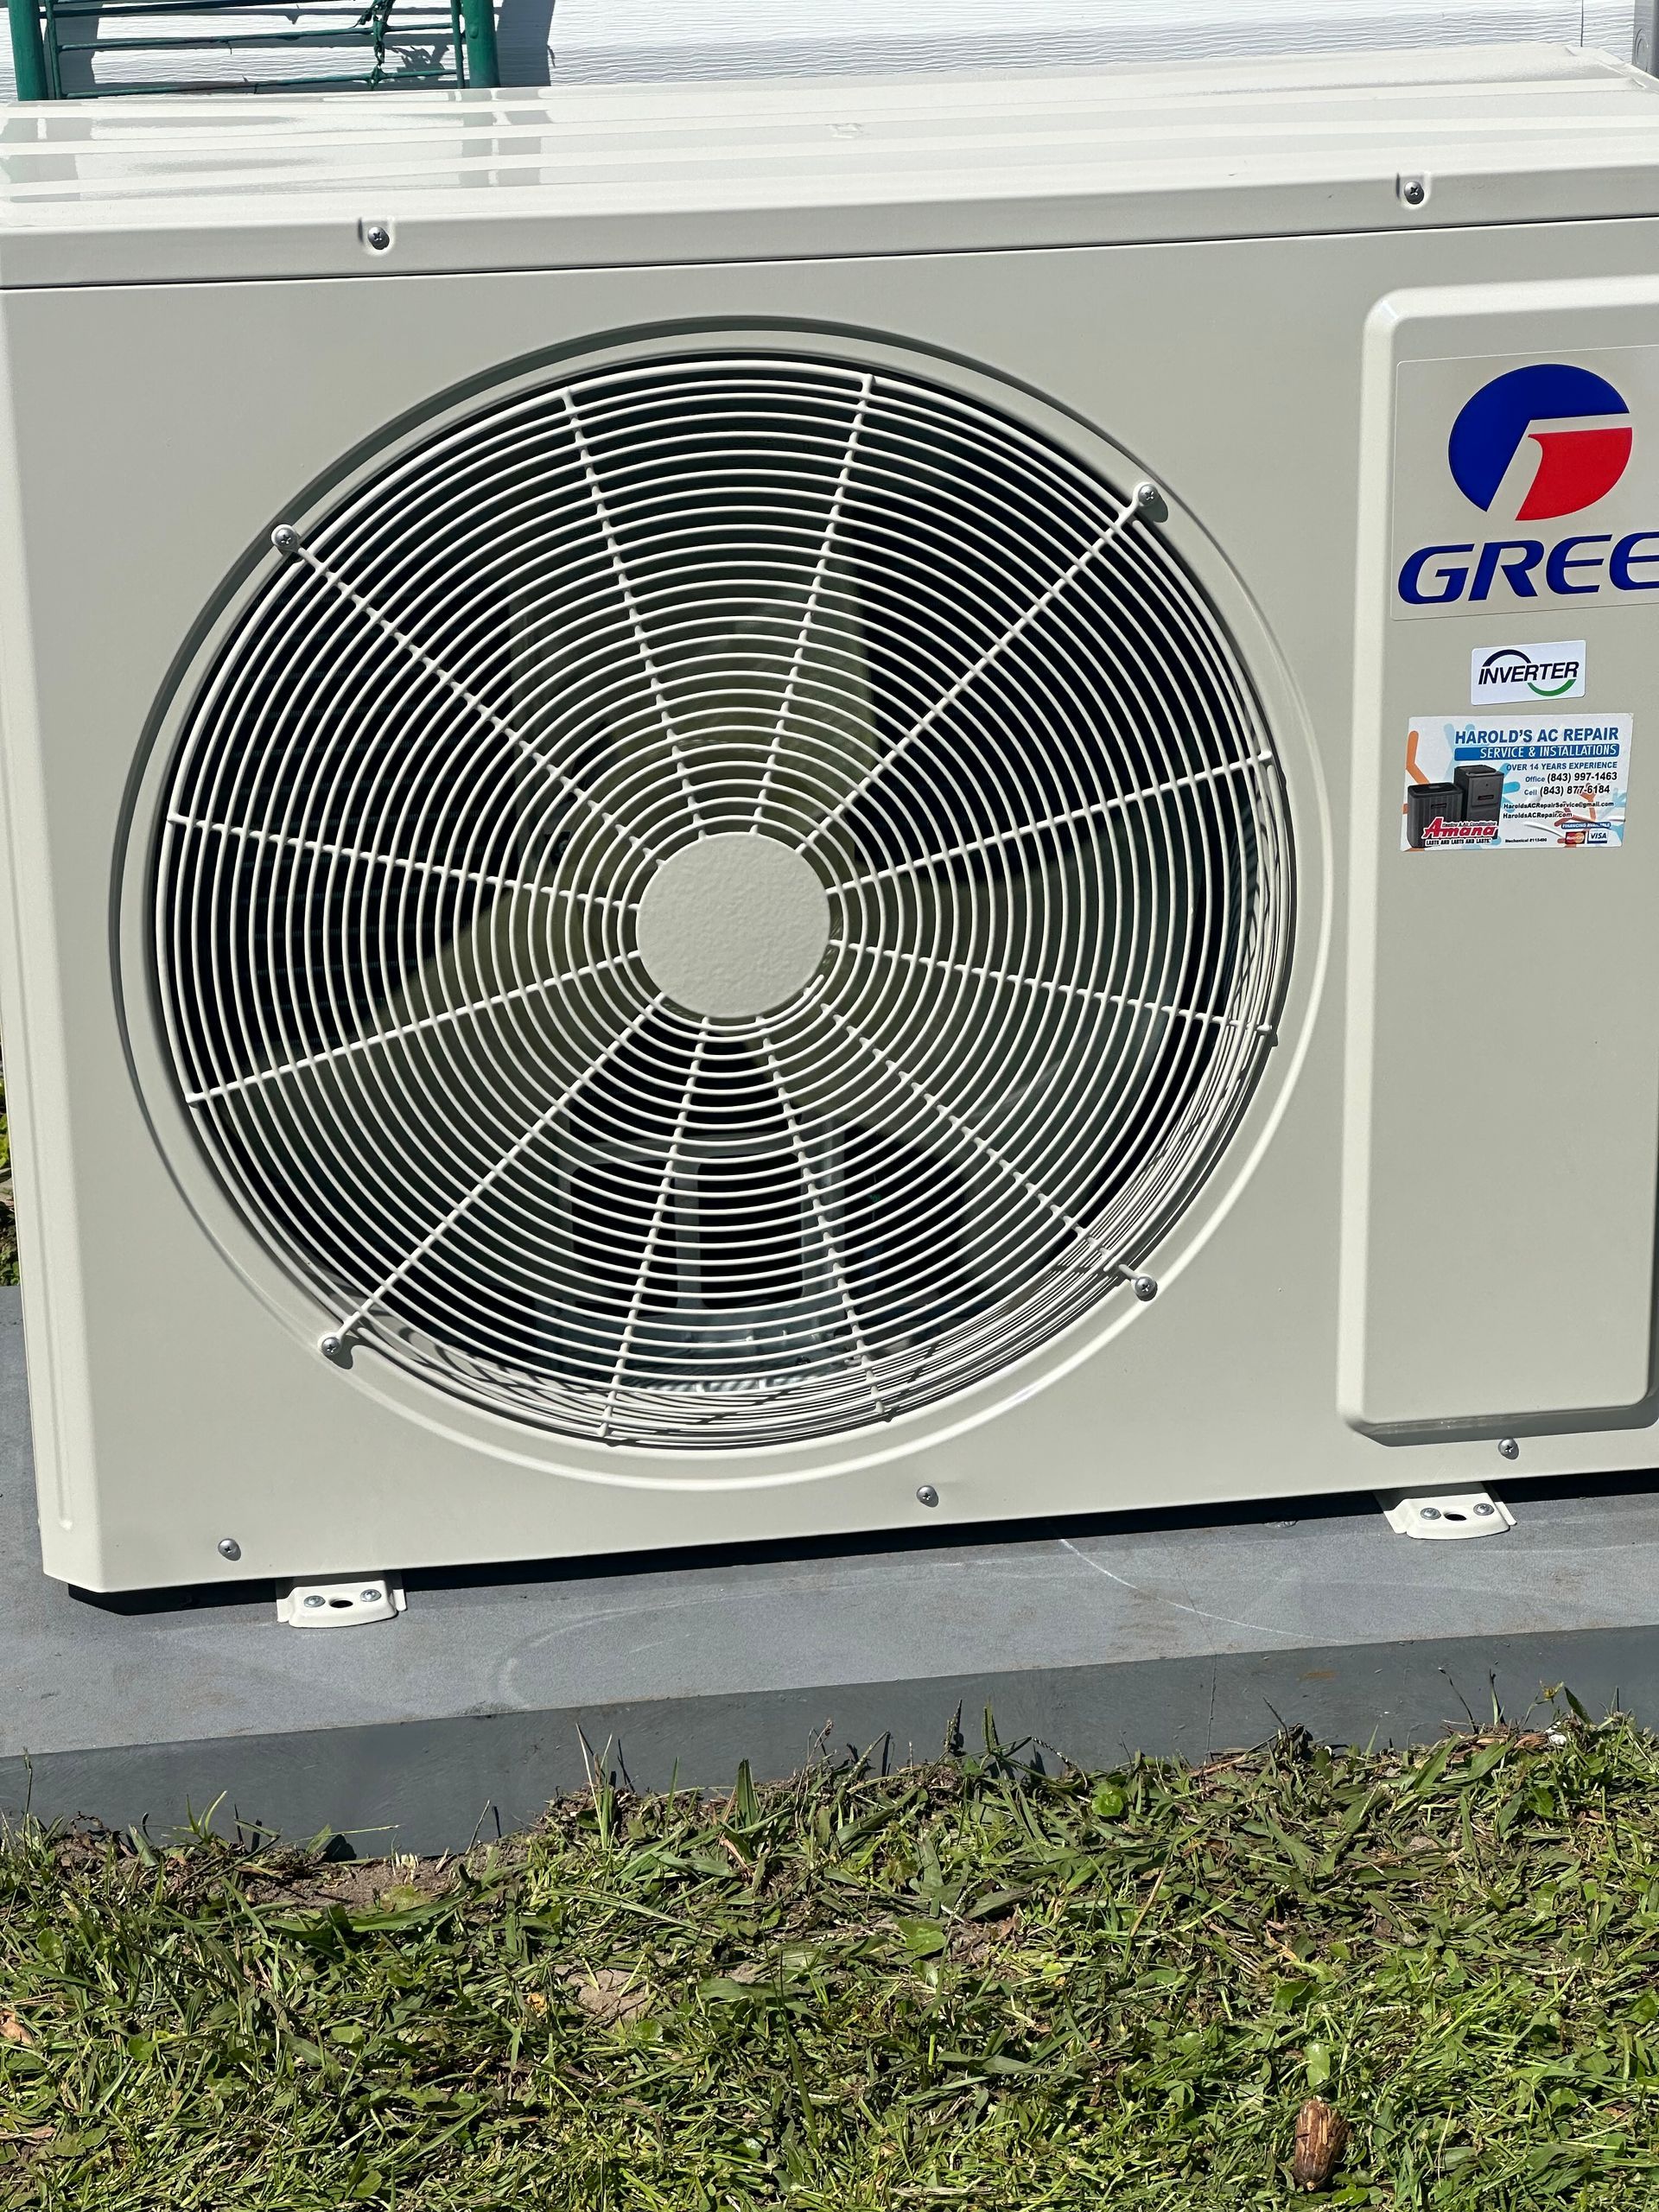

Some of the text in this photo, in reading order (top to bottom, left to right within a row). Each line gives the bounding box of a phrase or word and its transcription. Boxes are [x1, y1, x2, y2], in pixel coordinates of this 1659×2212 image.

[1398, 531, 1659, 605] GREE
[1478, 661, 1580, 685] INVERTER
[1454, 727, 1619, 744] HAROLD'S AC REPAIR
[1479, 744, 1617, 759] SERVICE & INSTALLATIONS
[1568, 761, 1618, 770] EXPERIENCE
[1547, 772, 1571, 784] (843)
[1573, 772, 1618, 781] 997-1463
[1540, 785, 1564, 797] (843)
[1567, 785, 1610, 795] 877-6184
[1423, 817, 1497, 837] Amana
